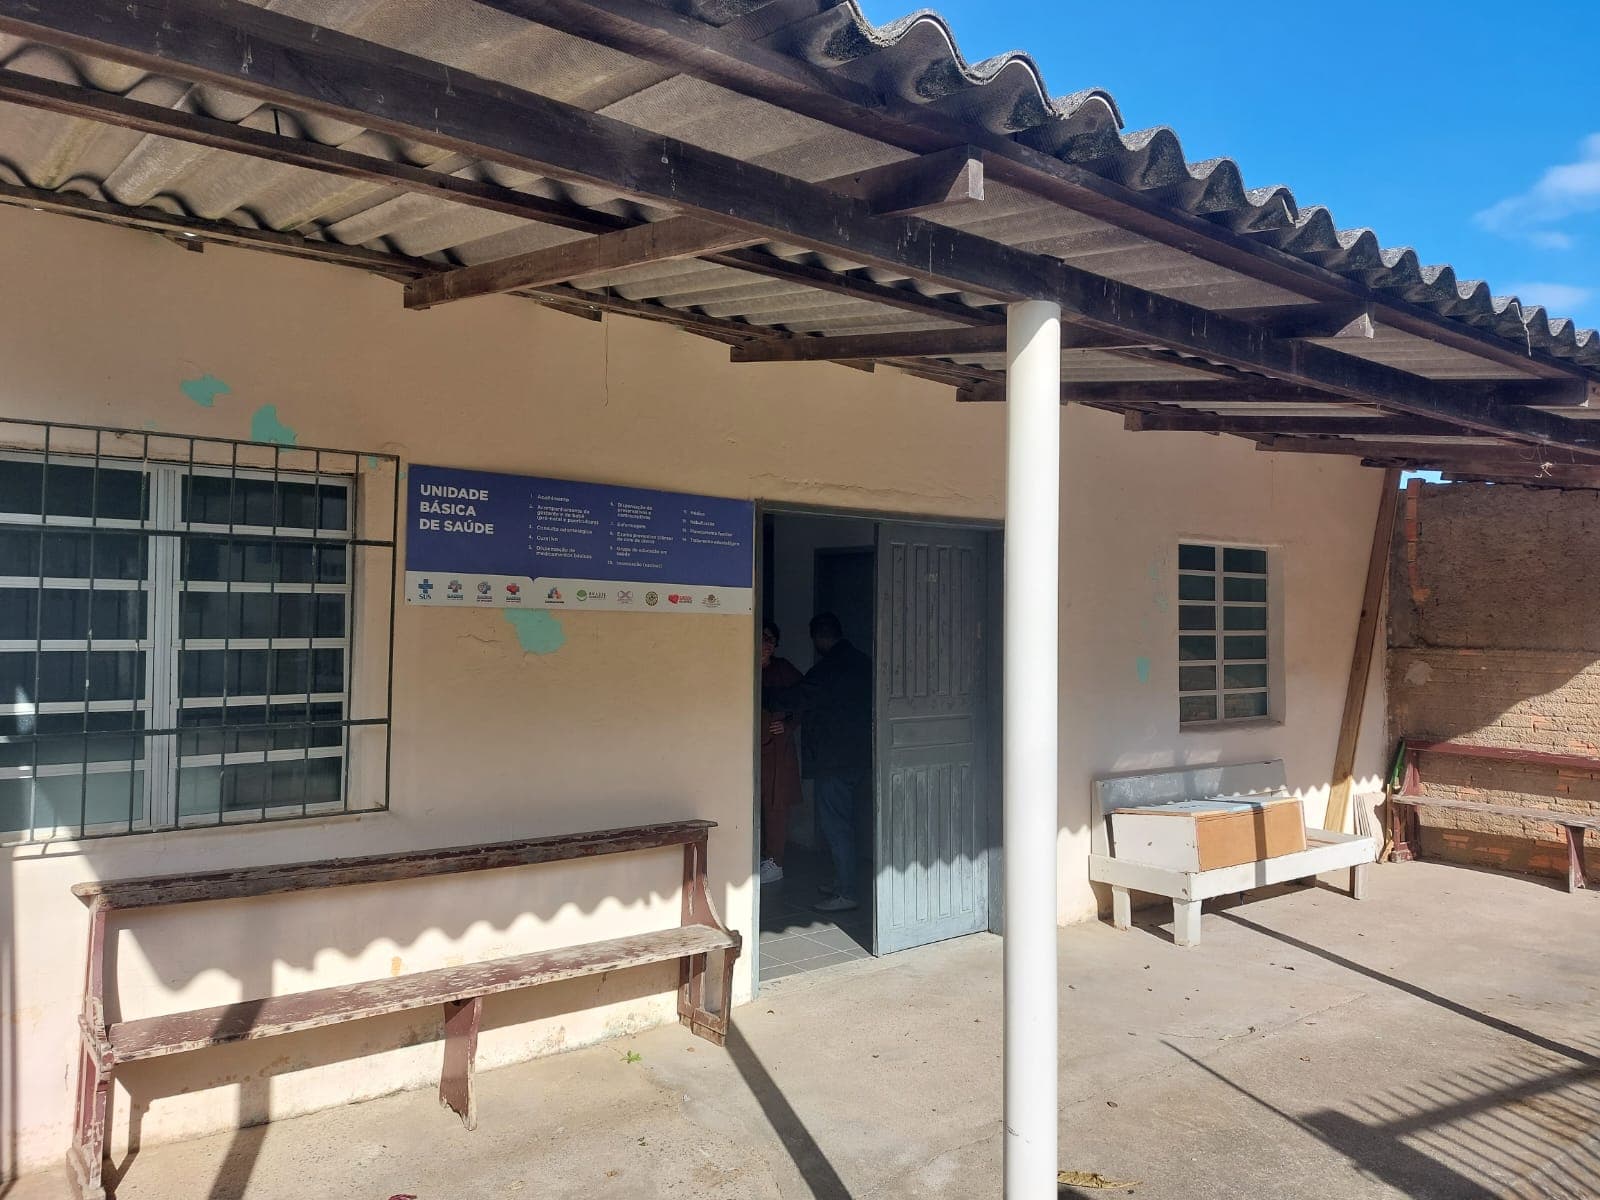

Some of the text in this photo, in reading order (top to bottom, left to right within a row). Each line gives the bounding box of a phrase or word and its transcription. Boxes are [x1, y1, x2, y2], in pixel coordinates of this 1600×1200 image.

[420, 484, 489, 501] UNIDADE
[420, 500, 477, 516] BÁSICA
[419, 518, 494, 535] DE SAÚDE
